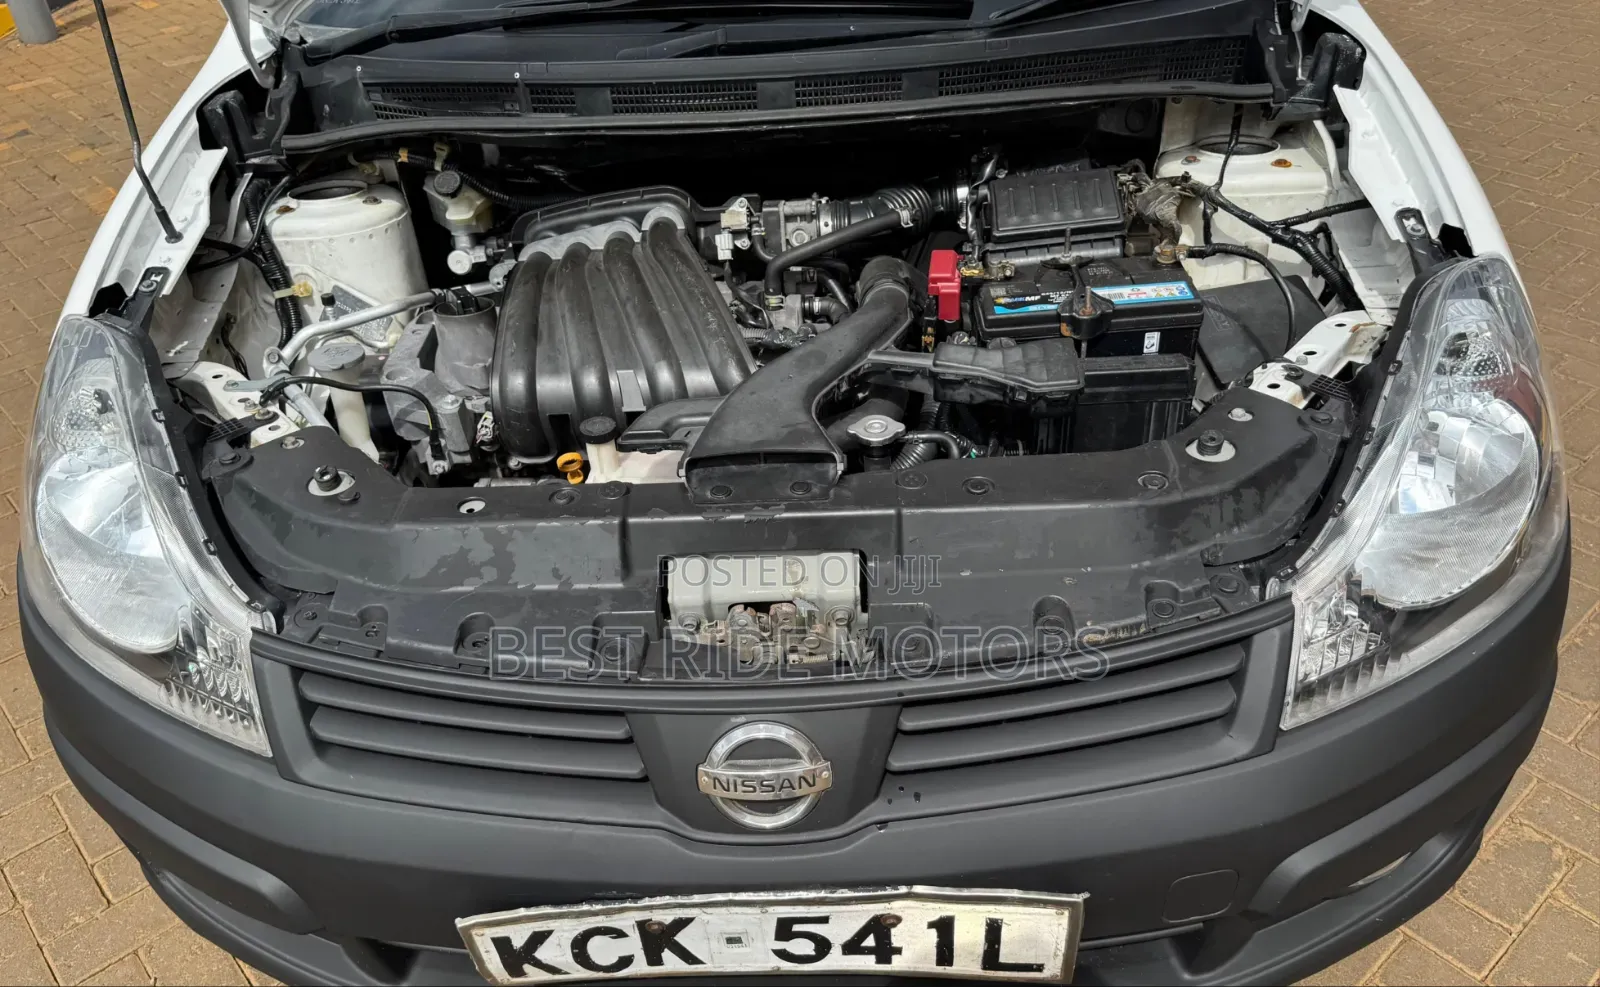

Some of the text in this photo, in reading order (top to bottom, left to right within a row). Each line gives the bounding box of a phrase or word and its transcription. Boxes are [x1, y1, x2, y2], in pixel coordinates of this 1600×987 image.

[713, 773, 817, 794] NISSAN
[490, 913, 1045, 979] KCK 541L
